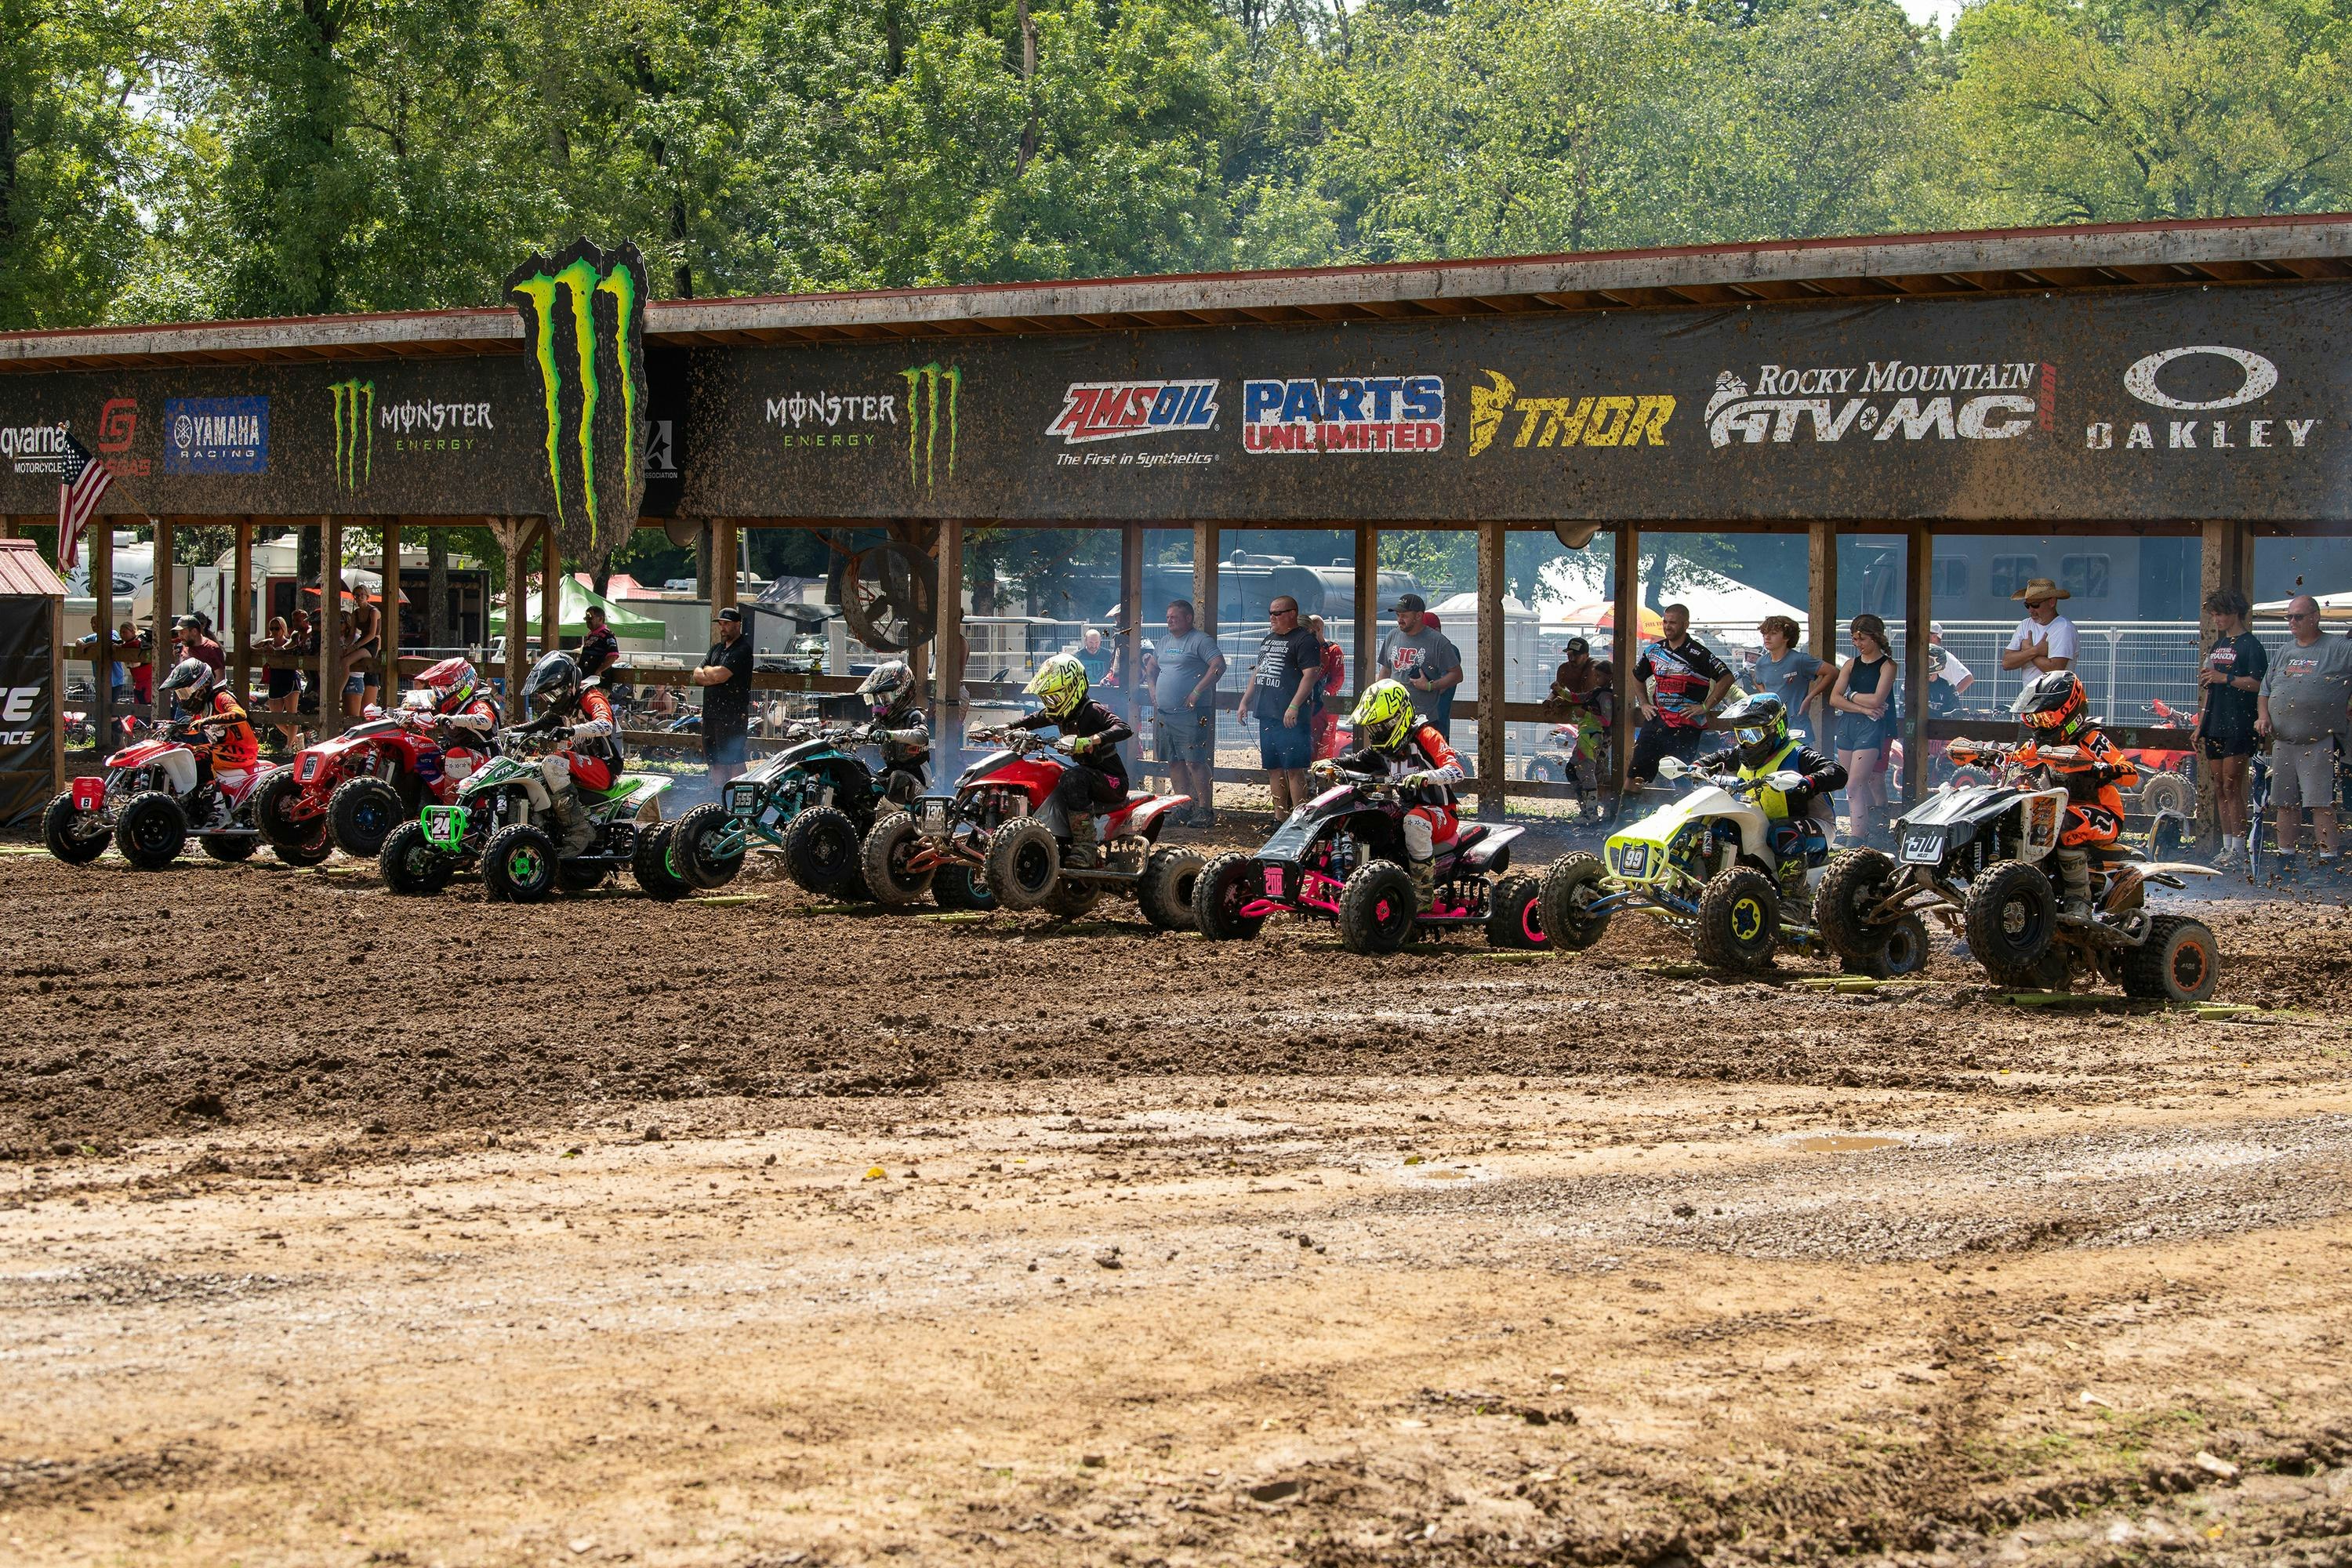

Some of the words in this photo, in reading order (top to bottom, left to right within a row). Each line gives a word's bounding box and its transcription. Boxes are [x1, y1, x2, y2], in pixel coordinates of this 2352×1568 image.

[1755, 364, 1857, 395] ROCKY
[1860, 361, 2036, 393] MOUNTAIN
[766, 390, 898, 428] MONSTER
[1052, 383, 1218, 443] AMSOIL
[1245, 379, 1443, 423] PARTS
[381, 399, 494, 434] MONSTER
[1513, 394, 1677, 448] THOR
[194, 416, 260, 446] YAMAHA
[397, 439, 475, 451] ENERGY
[785, 434, 875, 447] ENERGY
[1246, 423, 1443, 451] UNLIMITED
[2086, 419, 2316, 450] OAKLEY
[14, 463, 63, 473] MOTORCYCLE
[1057, 453, 1080, 464] The
[1083, 452, 1116, 464] First
[1120, 453, 1133, 464] in
[1135, 452, 1212, 468] Synthetics
[1266, 677, 1281, 688] DAD
[0, 688, 41, 721] E
[735, 792, 753, 806] 555
[433, 817, 451, 834] 24
[1625, 850, 1643, 868] 99
[1265, 874, 1283, 895] 208
